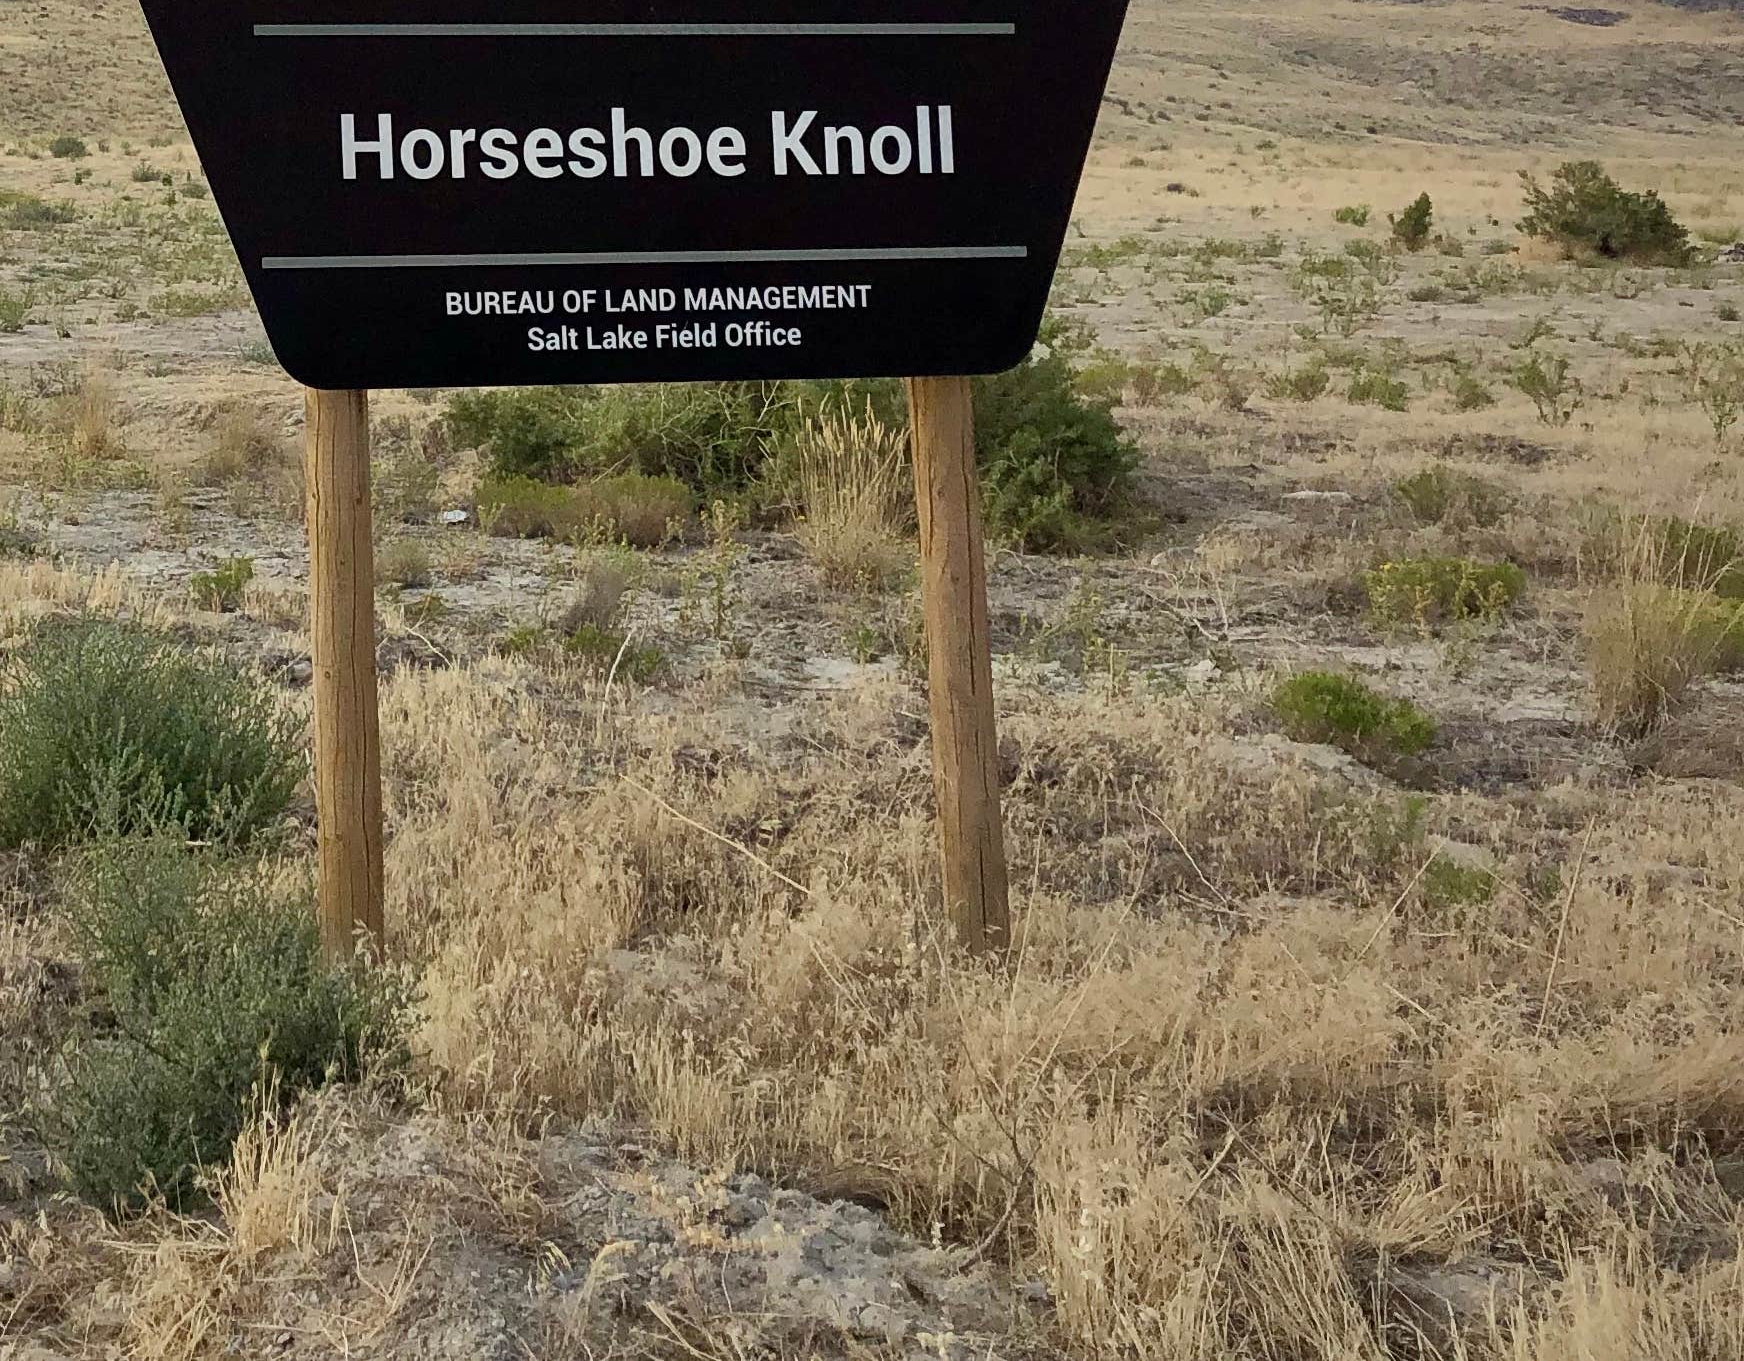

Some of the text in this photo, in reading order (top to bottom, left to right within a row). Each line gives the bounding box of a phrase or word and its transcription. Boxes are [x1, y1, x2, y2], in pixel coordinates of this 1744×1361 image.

[340, 105, 955, 180] Horseshoe Knoll
[445, 284, 872, 315] BUREAU OF LAND MANAGEMENT
[527, 320, 802, 351] Salt Lake Field Office
